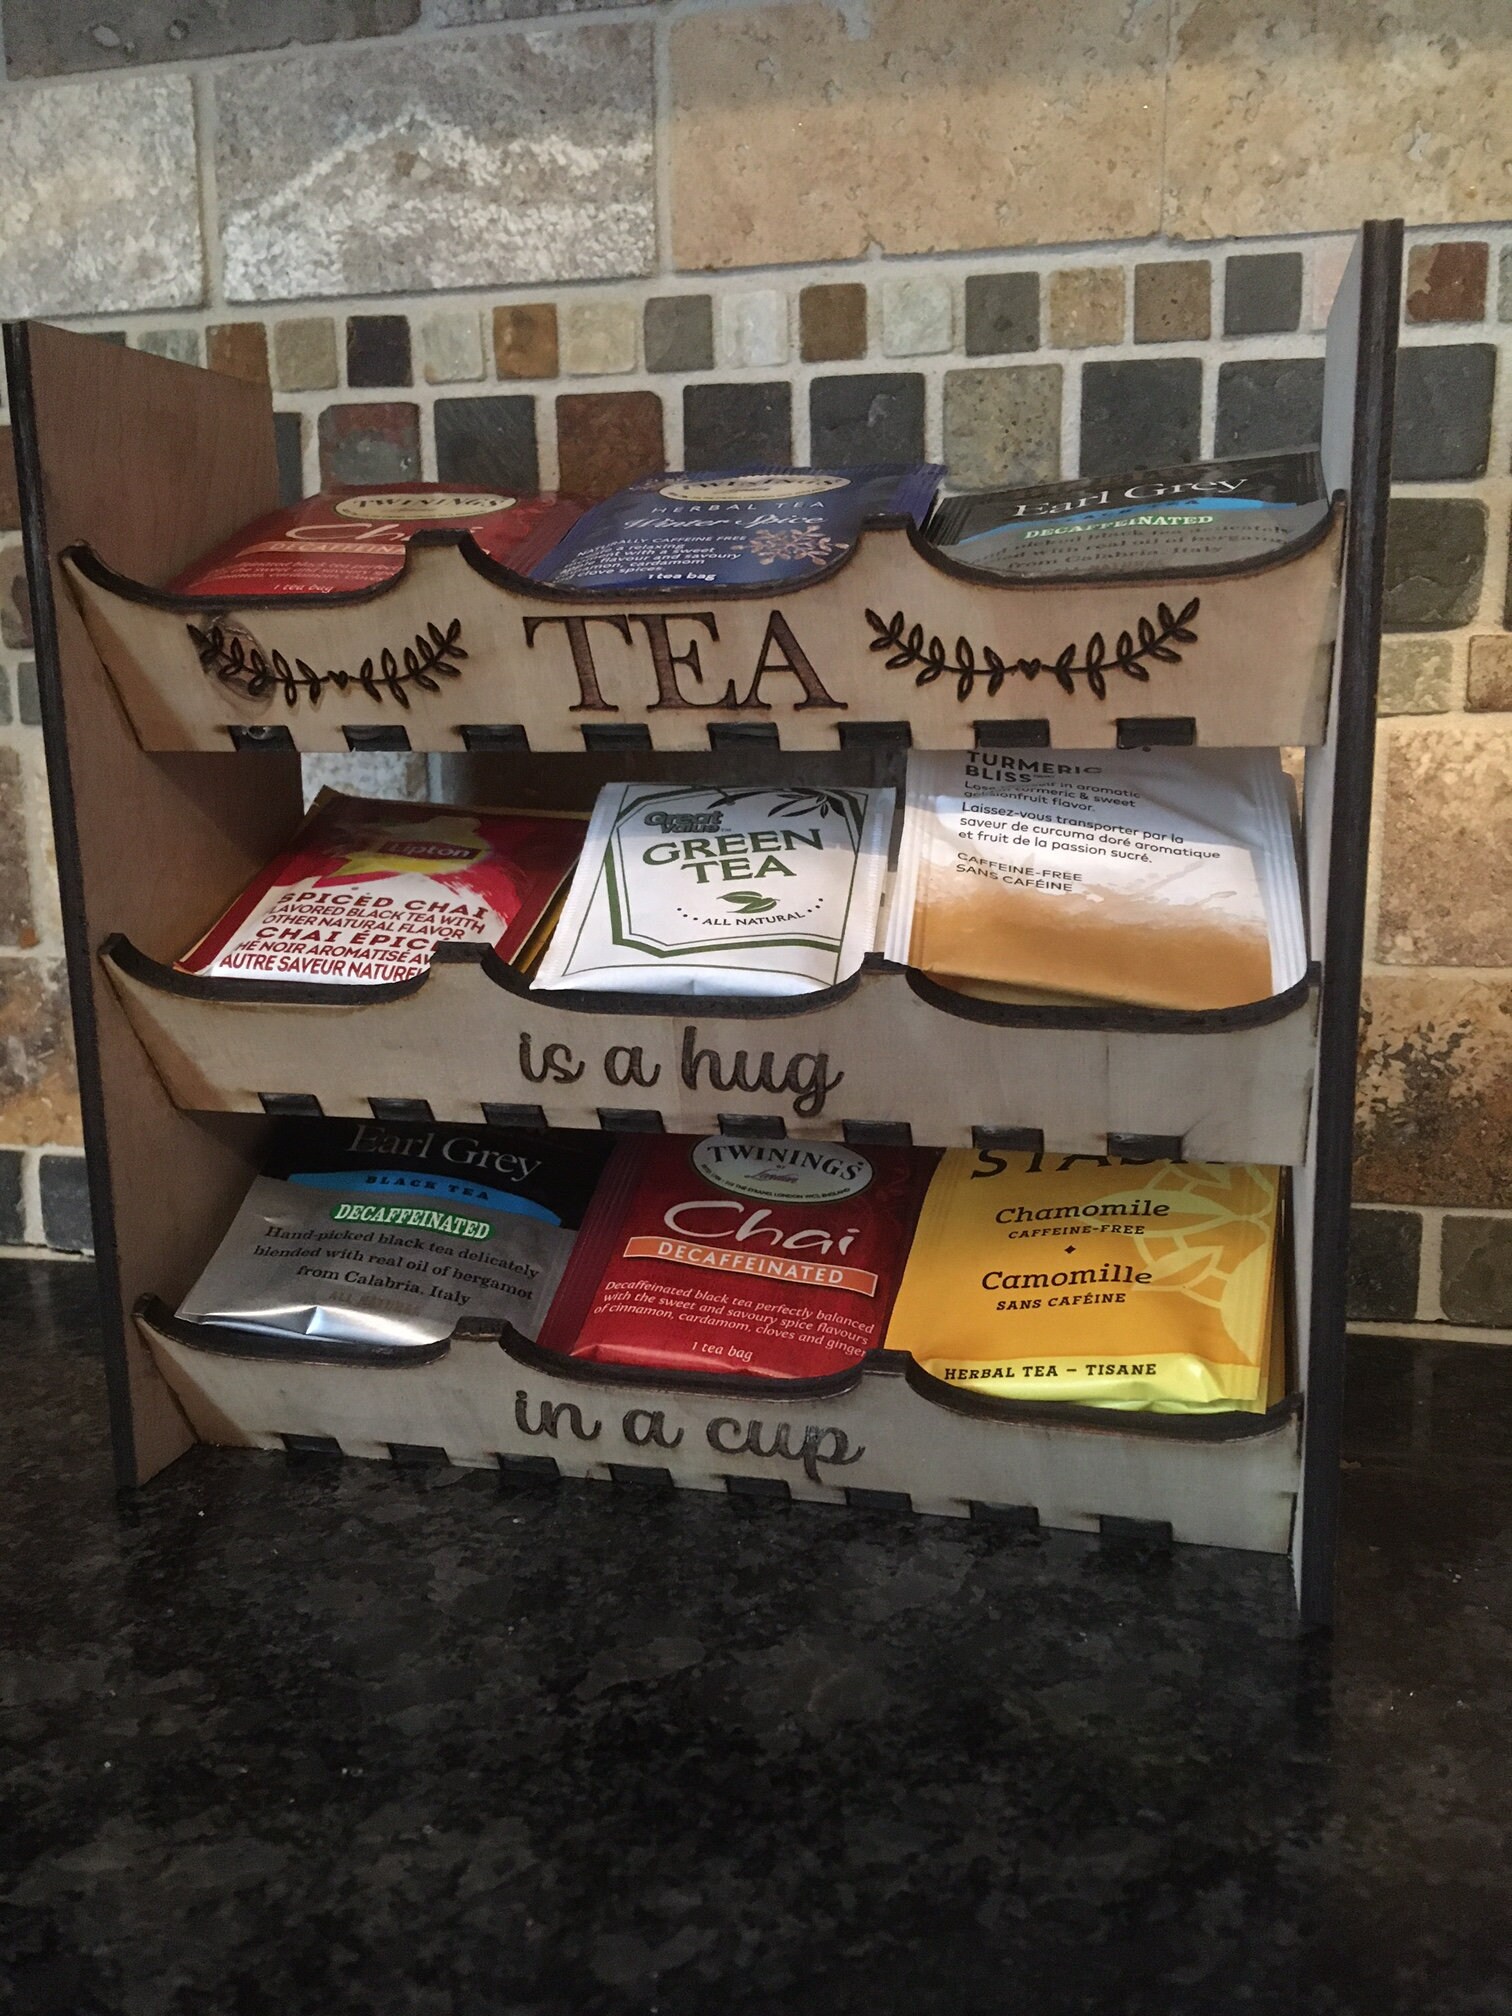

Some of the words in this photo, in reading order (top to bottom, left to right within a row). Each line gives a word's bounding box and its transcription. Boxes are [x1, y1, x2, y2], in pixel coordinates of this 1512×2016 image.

[651, 502, 756, 513] HERBAL
[776, 501, 826, 509] TEA
[1013, 490, 1110, 517] Earl
[1123, 478, 1249, 499] Grey
[624, 516, 730, 529] Winter
[1024, 515, 1214, 539] DECAFFEINATED
[652, 536, 713, 544] CAFFEINE
[600, 553, 650, 563] flavour
[652, 552, 680, 560] and
[684, 552, 742, 561] savoury
[629, 559, 706, 567] cardamom
[686, 572, 717, 581] bag
[522, 609, 849, 712] TEA
[965, 749, 1103, 775] TURMERIC
[965, 765, 1032, 783] BLISS
[1077, 783, 1142, 799] aromatic
[1079, 791, 1089, 800] &
[1093, 794, 1137, 808] sweet
[643, 810, 724, 827] Great
[660, 821, 721, 834] Value
[961, 801, 1053, 823] Laissez-vous
[1056, 814, 1141, 837] transporter
[1142, 830, 1168, 843] par
[1170, 833, 1184, 845] la
[391, 842, 472, 859] Lipton
[642, 828, 825, 866] GREEN
[958, 830, 974, 840] et
[976, 831, 1009, 845] fruit
[1012, 834, 1031, 847] de
[1034, 837, 1048, 848] la
[1051, 840, 1107, 856] passion
[1110, 848, 1153, 864] sucré.
[959, 817, 1008, 831] saveur
[1011, 820, 1029, 832] de
[1032, 825, 1095, 842] curcuma
[1098, 833, 1131, 848] doré
[1134, 840, 1221, 860] aromatique
[680, 854, 798, 885] TEA
[956, 863, 999, 881] SANS
[1002, 875, 1073, 892] CAFÉINE
[957, 852, 1083, 882] CAFFEINE-FREE
[278, 891, 395, 908] SPICED
[405, 899, 489, 920] CHAI
[702, 917, 732, 926] ALL
[735, 911, 806, 926] NATURAL
[262, 914, 318, 926] OTHER
[318, 916, 395, 932] NATURAL
[398, 922, 466, 940] FLAVOR
[348, 906, 402, 921] BLACK
[406, 911, 437, 923] TEA
[440, 915, 487, 935] WITH
[256, 926, 342, 943] CHAI
[219, 952, 277, 970] AUTRE
[277, 955, 347, 977] SAVEUR
[259, 940, 307, 954] NOIR
[305, 943, 411, 963] AROMATISÉ
[519, 1031, 586, 1084] is
[603, 1045, 662, 1087] a
[680, 1025, 845, 1118] hug
[346, 1123, 436, 1159] Earl
[442, 1136, 543, 1182] Grey
[706, 1144, 864, 1181] TWININGS
[365, 1175, 439, 1190] BLACK
[447, 1184, 490, 1200] TEA
[333, 1203, 491, 1240] DECAFFEINATED
[995, 1199, 1171, 1224] Chamomile
[663, 1200, 861, 1256] Chai
[1008, 1223, 1146, 1239] CAFFEINE-FREE
[264, 1225, 376, 1243] Hand-picked
[377, 1232, 425, 1250] black
[429, 1241, 454, 1256] tea
[458, 1247, 541, 1281] delicately
[657, 1241, 845, 1285] DECAFFEINATED
[253, 1244, 320, 1258] blended
[325, 1247, 365, 1263] with
[367, 1251, 403, 1268] real
[405, 1259, 428, 1273] oil
[431, 1263, 454, 1276] of
[452, 1266, 535, 1300] bergamot
[295, 1264, 340, 1281] from
[429, 1284, 472, 1306] Italy
[981, 1263, 1153, 1291] Camomille
[604, 1280, 694, 1299] Decaffeinated
[694, 1289, 730, 1305] black
[732, 1297, 753, 1309] tea
[755, 1300, 814, 1321] perfectly
[816, 1309, 876, 1335] balanced
[996, 1298, 1043, 1311] SANS
[1047, 1291, 1127, 1308] CAFÉINE
[593, 1303, 611, 1315] of
[610, 1303, 675, 1321] cinnamon,
[678, 1311, 752, 1334] cardamom,
[755, 1325, 795, 1341] cloves
[798, 1331, 823, 1345] and
[603, 1291, 632, 1303] with
[634, 1292, 656, 1305] the
[658, 1298, 697, 1311] sweet
[699, 1302, 724, 1316] and
[726, 1308, 779, 1326] savoury
[780, 1314, 814, 1333] spice
[815, 1322, 869, 1346] flavours
[701, 1343, 724, 1356] tea
[727, 1344, 754, 1363] bag
[944, 1366, 1015, 1380] HERBAL
[1022, 1365, 1059, 1378] TEA
[1085, 1363, 1158, 1377] TISANE
[514, 1389, 603, 1441] in
[621, 1408, 685, 1449] a
[705, 1415, 867, 1484] cup
